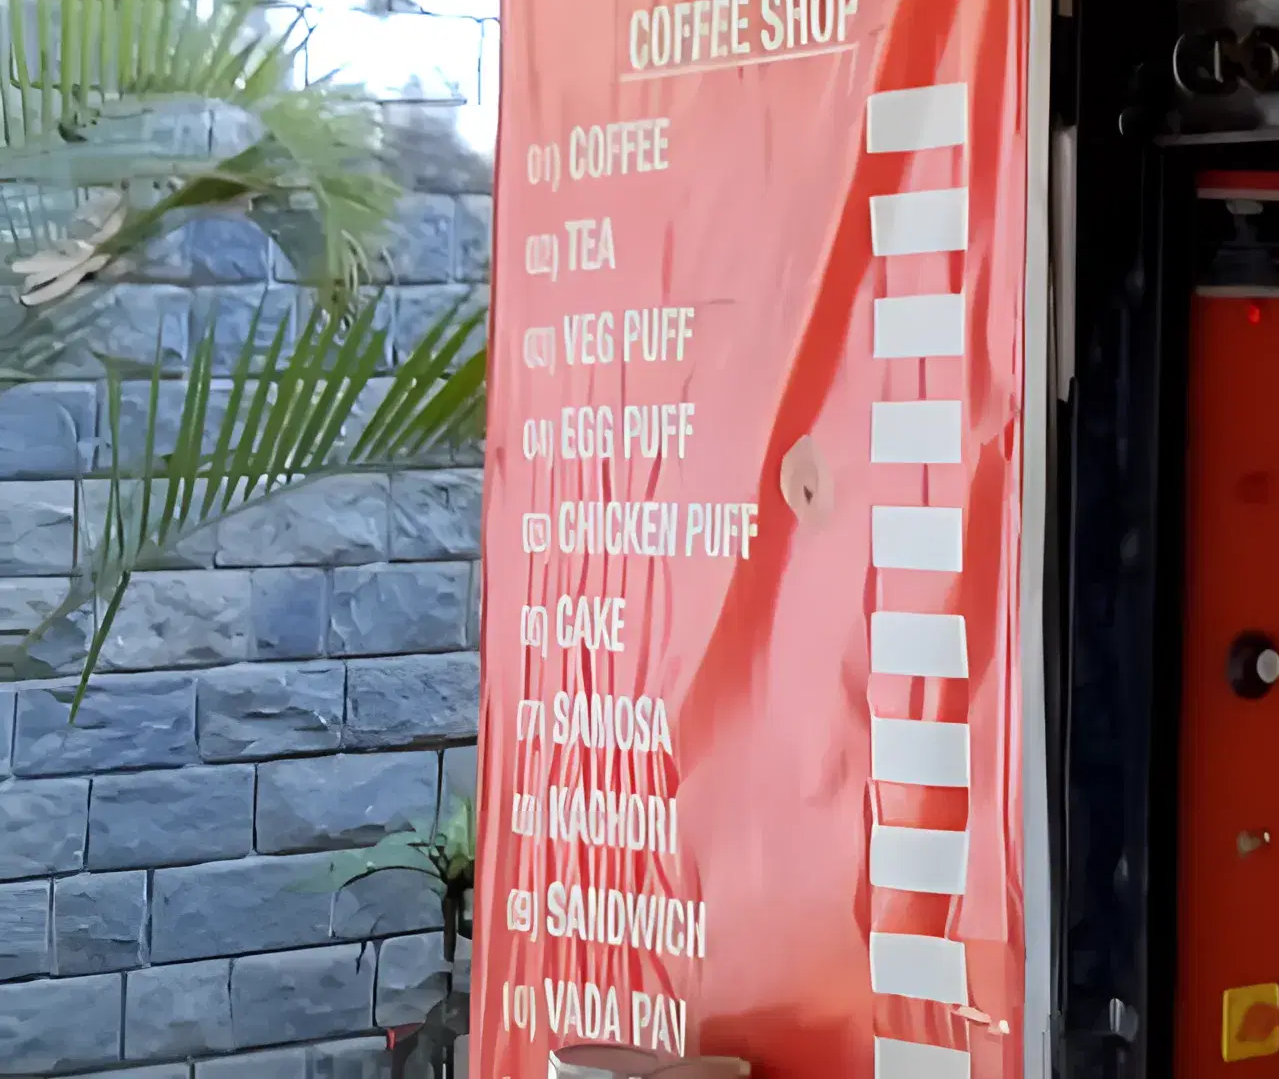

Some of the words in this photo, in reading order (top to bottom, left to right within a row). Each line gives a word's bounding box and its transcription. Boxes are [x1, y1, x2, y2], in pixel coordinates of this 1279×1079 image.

[569, 117, 670, 180] COFFEE
[564, 216, 616, 271] TEA
[563, 311, 614, 366] VEG
[624, 307, 695, 362] PUFF
[561, 405, 613, 459] EGG
[623, 403, 695, 459] PUFF
[558, 501, 677, 556] CHICKEN
[685, 503, 758, 559] PUFF
[556, 594, 626, 652] CAKE
[553, 690, 673, 754] SAMOSA
[544, 977, 621, 1041] VADA
